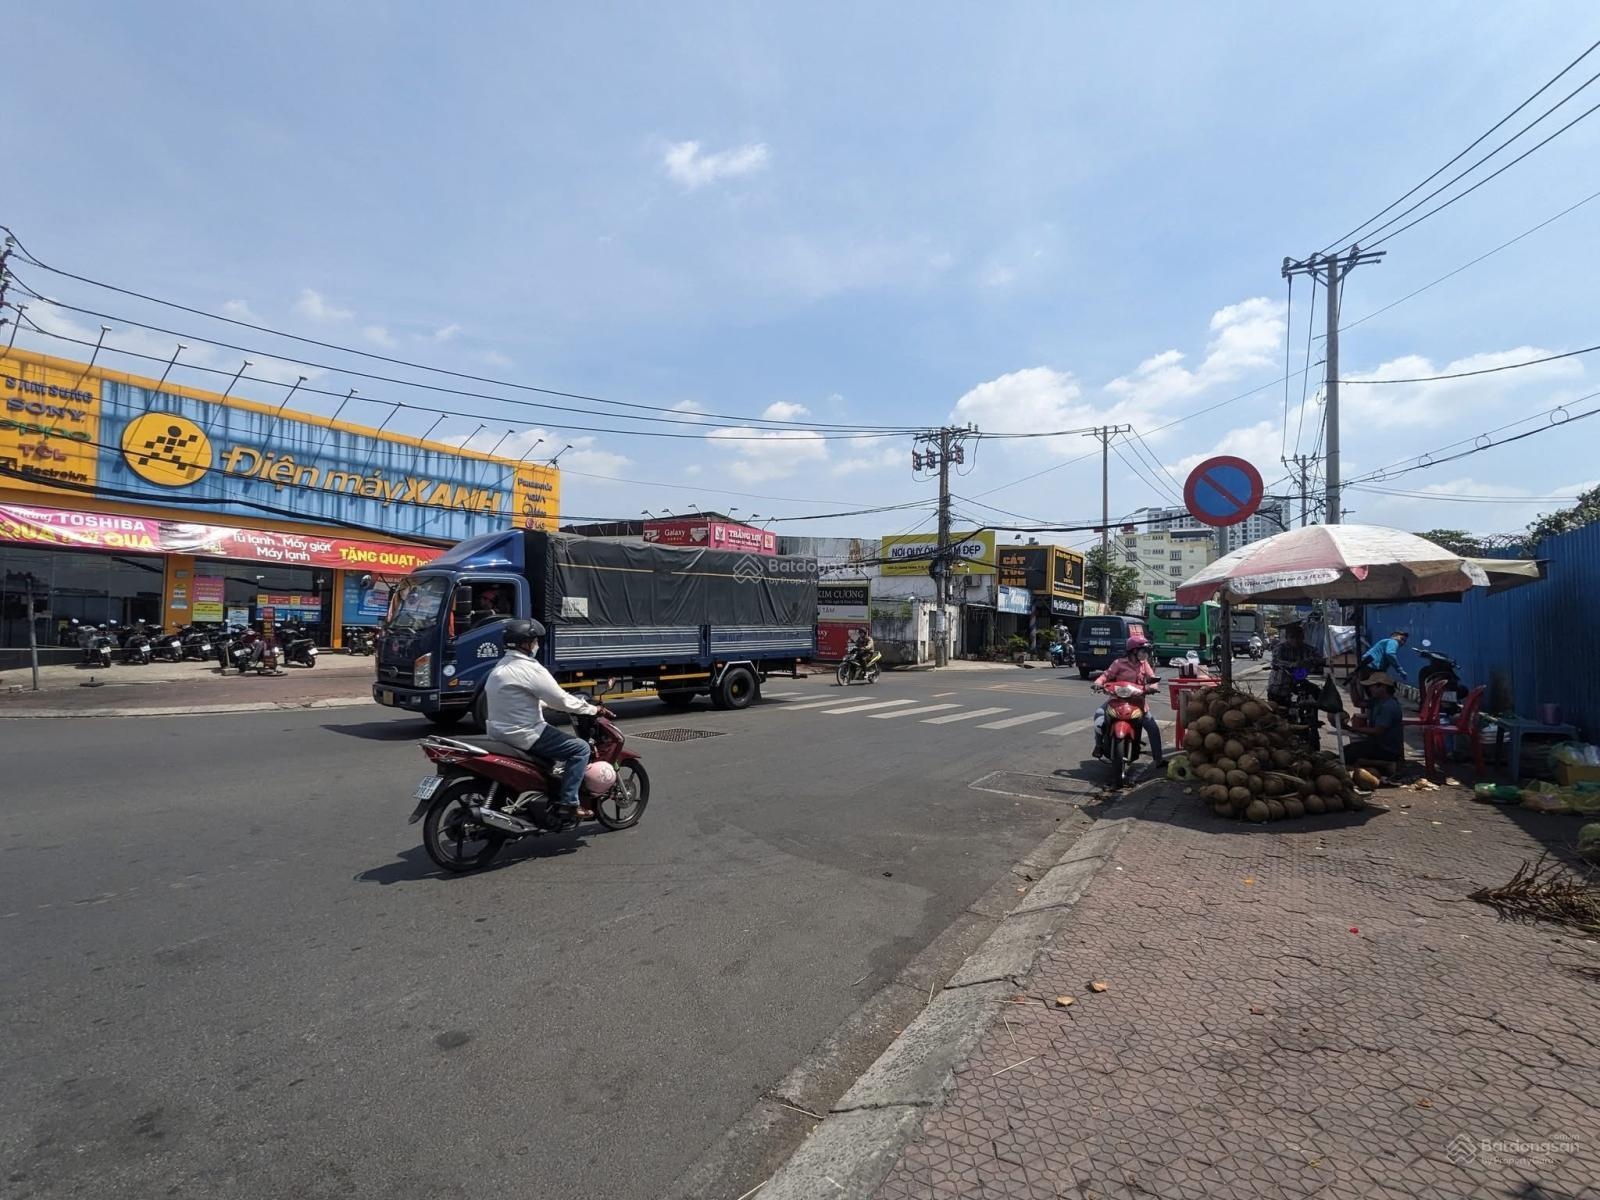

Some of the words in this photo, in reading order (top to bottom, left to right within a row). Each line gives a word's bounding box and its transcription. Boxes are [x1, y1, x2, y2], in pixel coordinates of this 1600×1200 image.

[5, 376, 93, 404] SAMSUNG
[17, 442, 67, 462] TCL
[220, 445, 319, 492] Điện
[324, 470, 403, 507] máy
[401, 476, 502, 517] XANH
[59, 513, 146, 532] TOSHIBA
[234, 530, 245, 543] Tủ
[248, 535, 275, 546] lạnh
[282, 538, 308, 549] Máy
[309, 541, 332, 553] giặt
[664, 528, 686, 538] Galaxy
[256, 547, 284, 559] Máy
[285, 549, 311, 562] lạnh
[339, 547, 377, 564] TẶNG
[379, 552, 415, 568] QUẠT
[962, 545, 981, 557] ĐẸP
